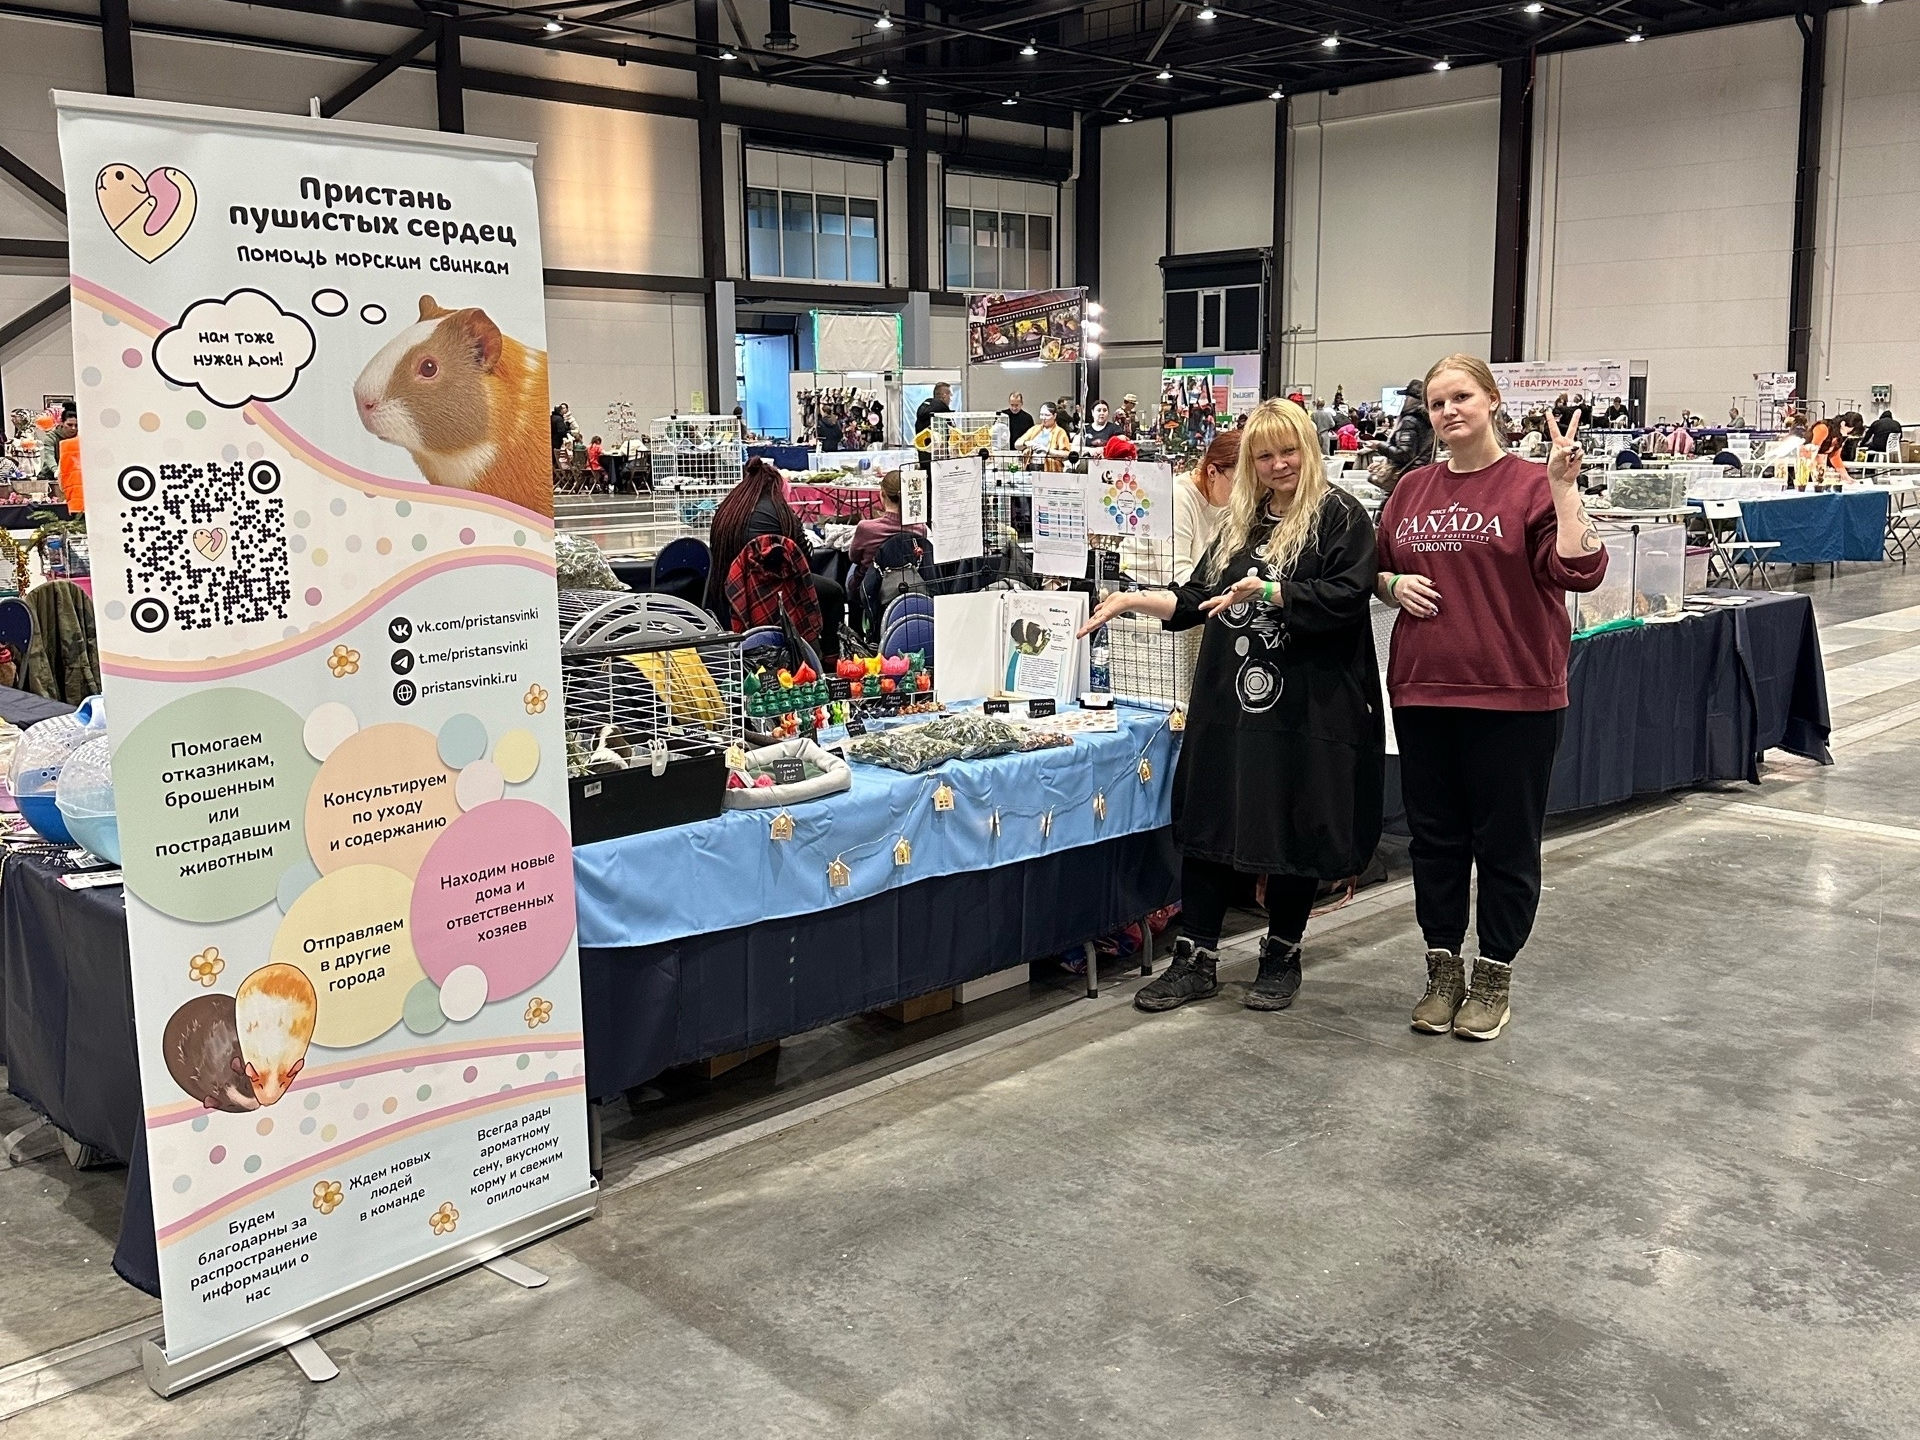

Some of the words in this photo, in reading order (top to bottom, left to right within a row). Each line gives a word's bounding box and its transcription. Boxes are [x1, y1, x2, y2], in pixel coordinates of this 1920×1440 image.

[300, 177, 451, 210] Пристань
[230, 206, 399, 235] пушистых
[407, 219, 516, 247] сердец
[430, 255, 509, 275] свинкам
[1513, 378, 1583, 389] НЕВАГРУМ-2025
[1395, 512, 1503, 540] CANADA
[1408, 534, 1429, 542] STATE
[1443, 533, 1490, 542] POSITIVITY
[1411, 542, 1462, 553] TORONTO
[417, 607, 538, 633] vk.com/pristansvinki
[419, 639, 528, 664] t.me/pristansvinki
[422, 672, 517, 698] pristansvinki.ru
[171, 733, 262, 758] Помогаем
[162, 755, 274, 783] отказникам,
[165, 777, 274, 809] брошенным
[324, 774, 446, 808] Консультируем
[209, 807, 239, 824] или
[353, 811, 372, 824] по
[377, 800, 422, 822] уходу
[156, 820, 290, 857] пострадавшим
[330, 840, 339, 851] и
[345, 817, 446, 847] содержанию
[180, 846, 273, 877] животным
[441, 865, 506, 890] Находим
[511, 854, 554, 872] новые
[475, 884, 511, 904] дома
[516, 881, 525, 891] и
[447, 893, 554, 930] ответственных
[303, 919, 403, 953] Отправляем
[478, 921, 527, 942] хозяев
[321, 961, 330, 972] в
[335, 944, 390, 970] другие
[329, 967, 385, 992] города
[478, 1120, 518, 1141] Всегда
[522, 1107, 551, 1127] рады
[481, 1124, 550, 1157] ароматному
[350, 1168, 387, 1190] Ждем
[391, 1152, 431, 1173] новых
[473, 1160, 502, 1177] сену,
[506, 1137, 559, 1164] вкусному
[370, 1173, 412, 1200] людей
[471, 1174, 506, 1195] корму
[510, 1170, 517, 1179] и
[520, 1152, 562, 1175] свежим
[487, 1173, 549, 1205] опилочкам
[360, 1212, 367, 1221] в
[371, 1189, 425, 1217] команде
[229, 1211, 275, 1234] Будем
[198, 1225, 287, 1265] благодарны
[292, 1218, 307, 1230] за
[191, 1232, 317, 1291] распространение
[203, 1258, 296, 1302] информации
[301, 1254, 309, 1263] о
[246, 1287, 270, 1304] нас
